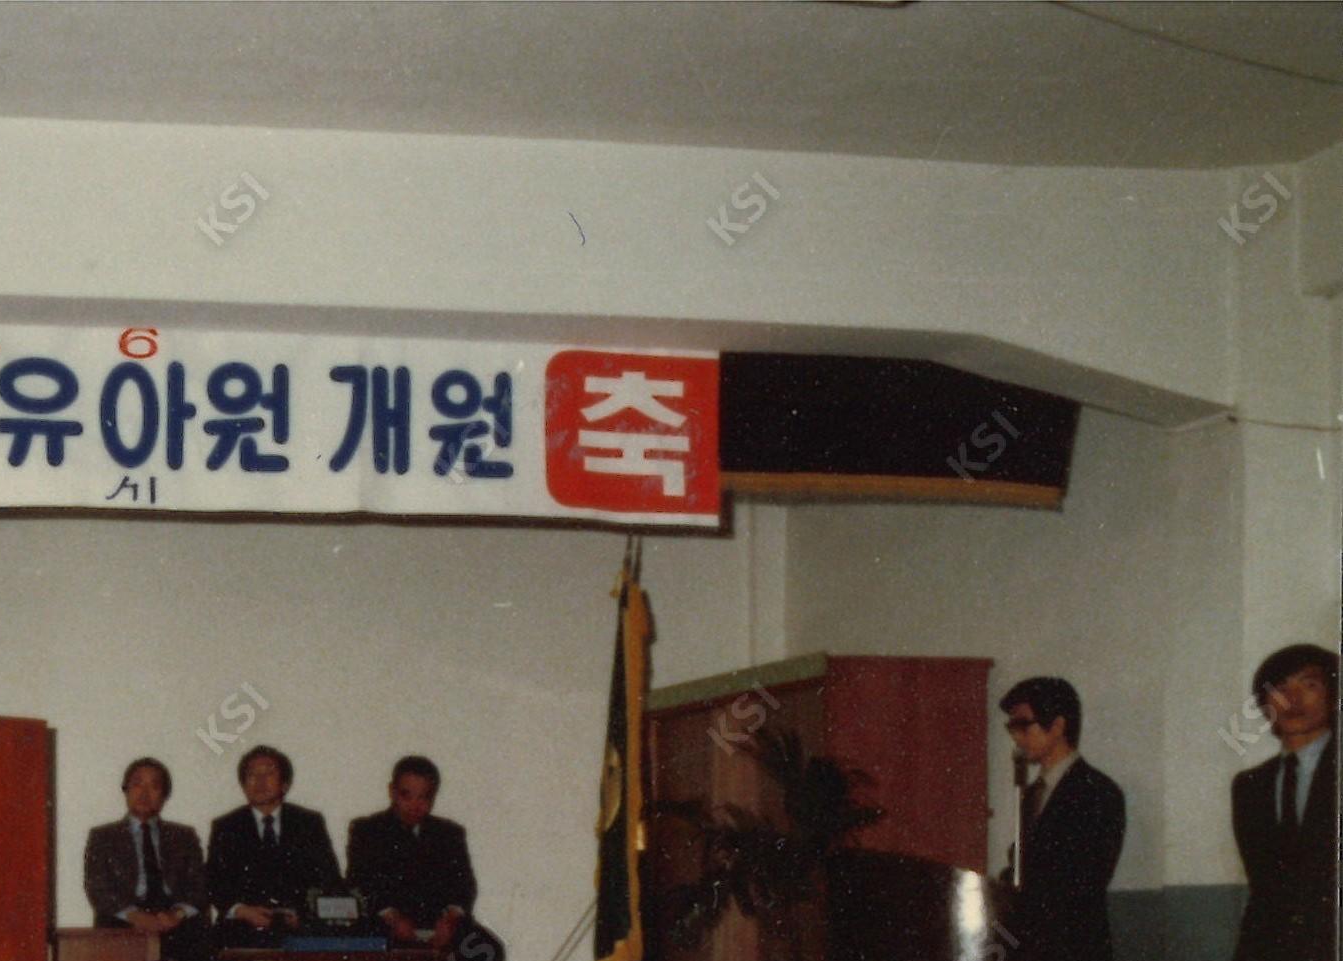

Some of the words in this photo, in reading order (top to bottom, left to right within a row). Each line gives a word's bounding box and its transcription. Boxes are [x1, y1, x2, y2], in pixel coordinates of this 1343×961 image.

[117, 326, 160, 361] 6
[327, 364, 515, 478] 개원
[578, 371, 690, 497] 축
